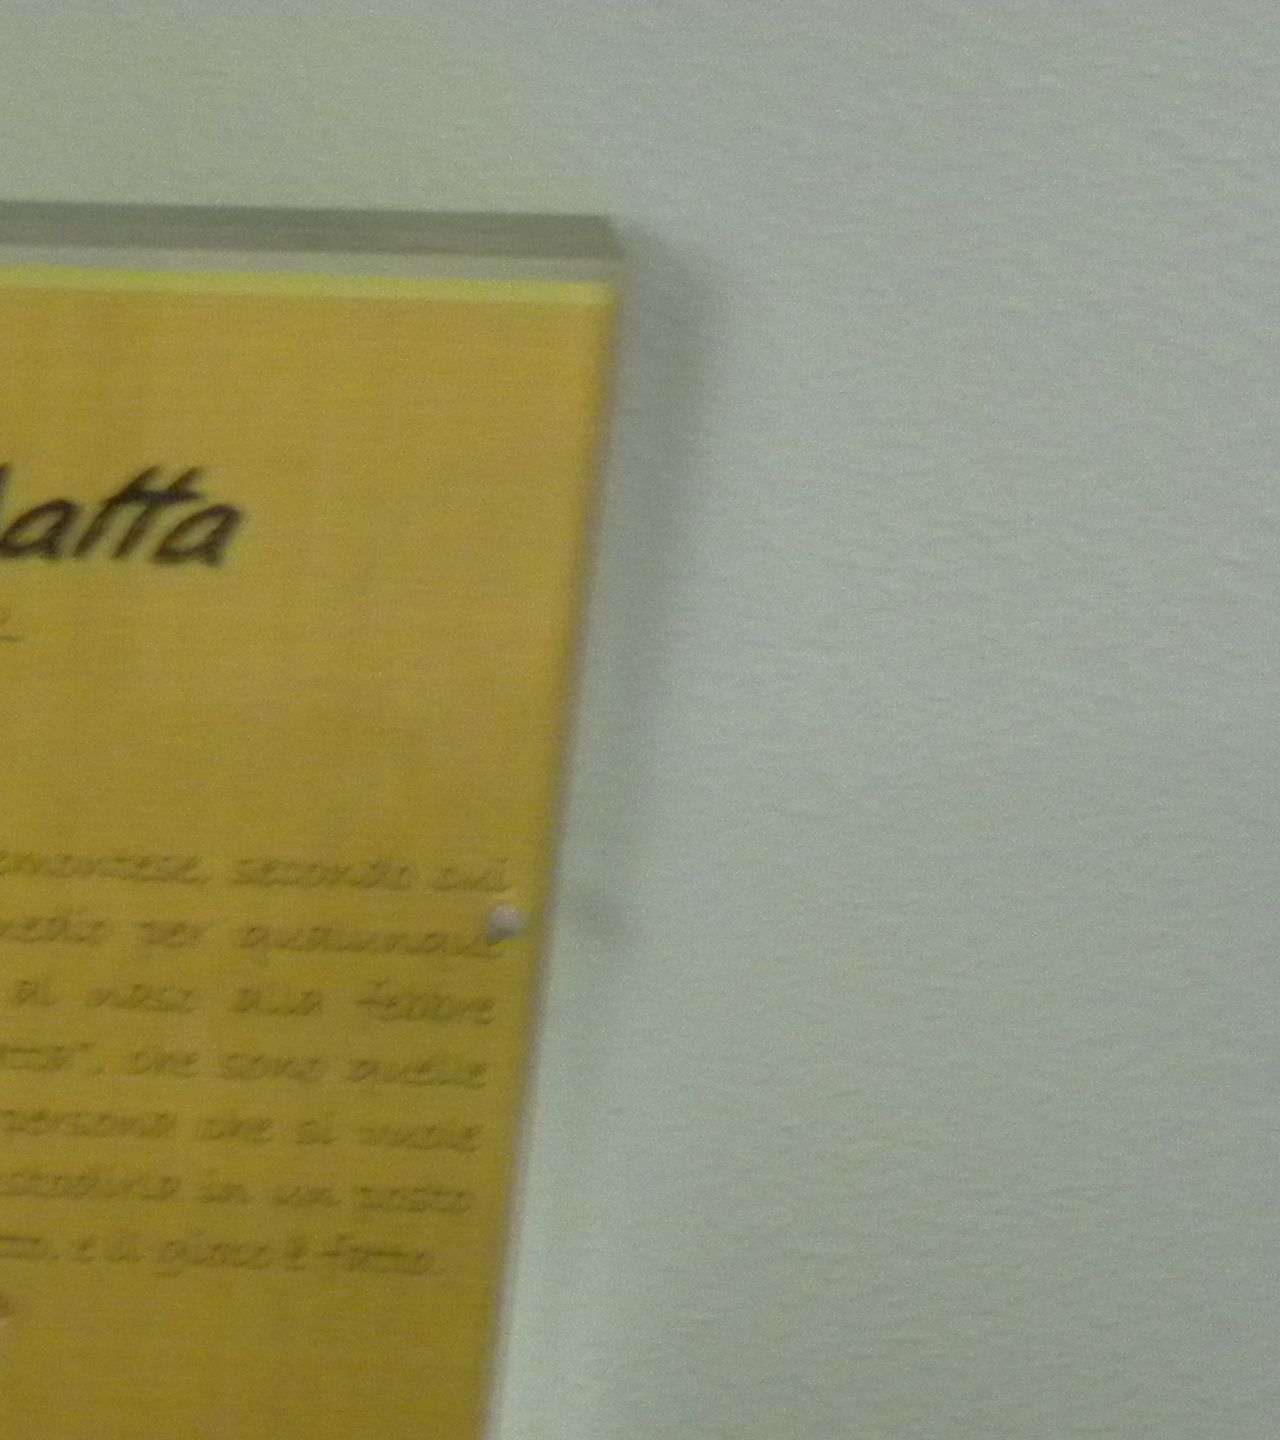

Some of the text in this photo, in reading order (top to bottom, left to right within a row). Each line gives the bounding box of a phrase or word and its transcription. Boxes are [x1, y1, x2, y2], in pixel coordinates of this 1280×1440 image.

[230, 852, 418, 892] secondo
[432, 857, 510, 893] cui
[137, 920, 212, 955] per
[10, 976, 58, 1008] al
[82, 986, 200, 1015] naso
[230, 982, 324, 1017] alla
[353, 979, 498, 1027] febbre
[123, 1047, 202, 1079] che
[217, 1051, 327, 1083] sono
[344, 1052, 492, 1097] quelle
[194, 1113, 275, 1146] che
[294, 1108, 338, 1146] si
[352, 1113, 485, 1153] vuole
[195, 1167, 251, 1204] in
[269, 1182, 339, 1206] un
[352, 1182, 476, 1216] posto
[150, 1227, 273, 1277] gioco
